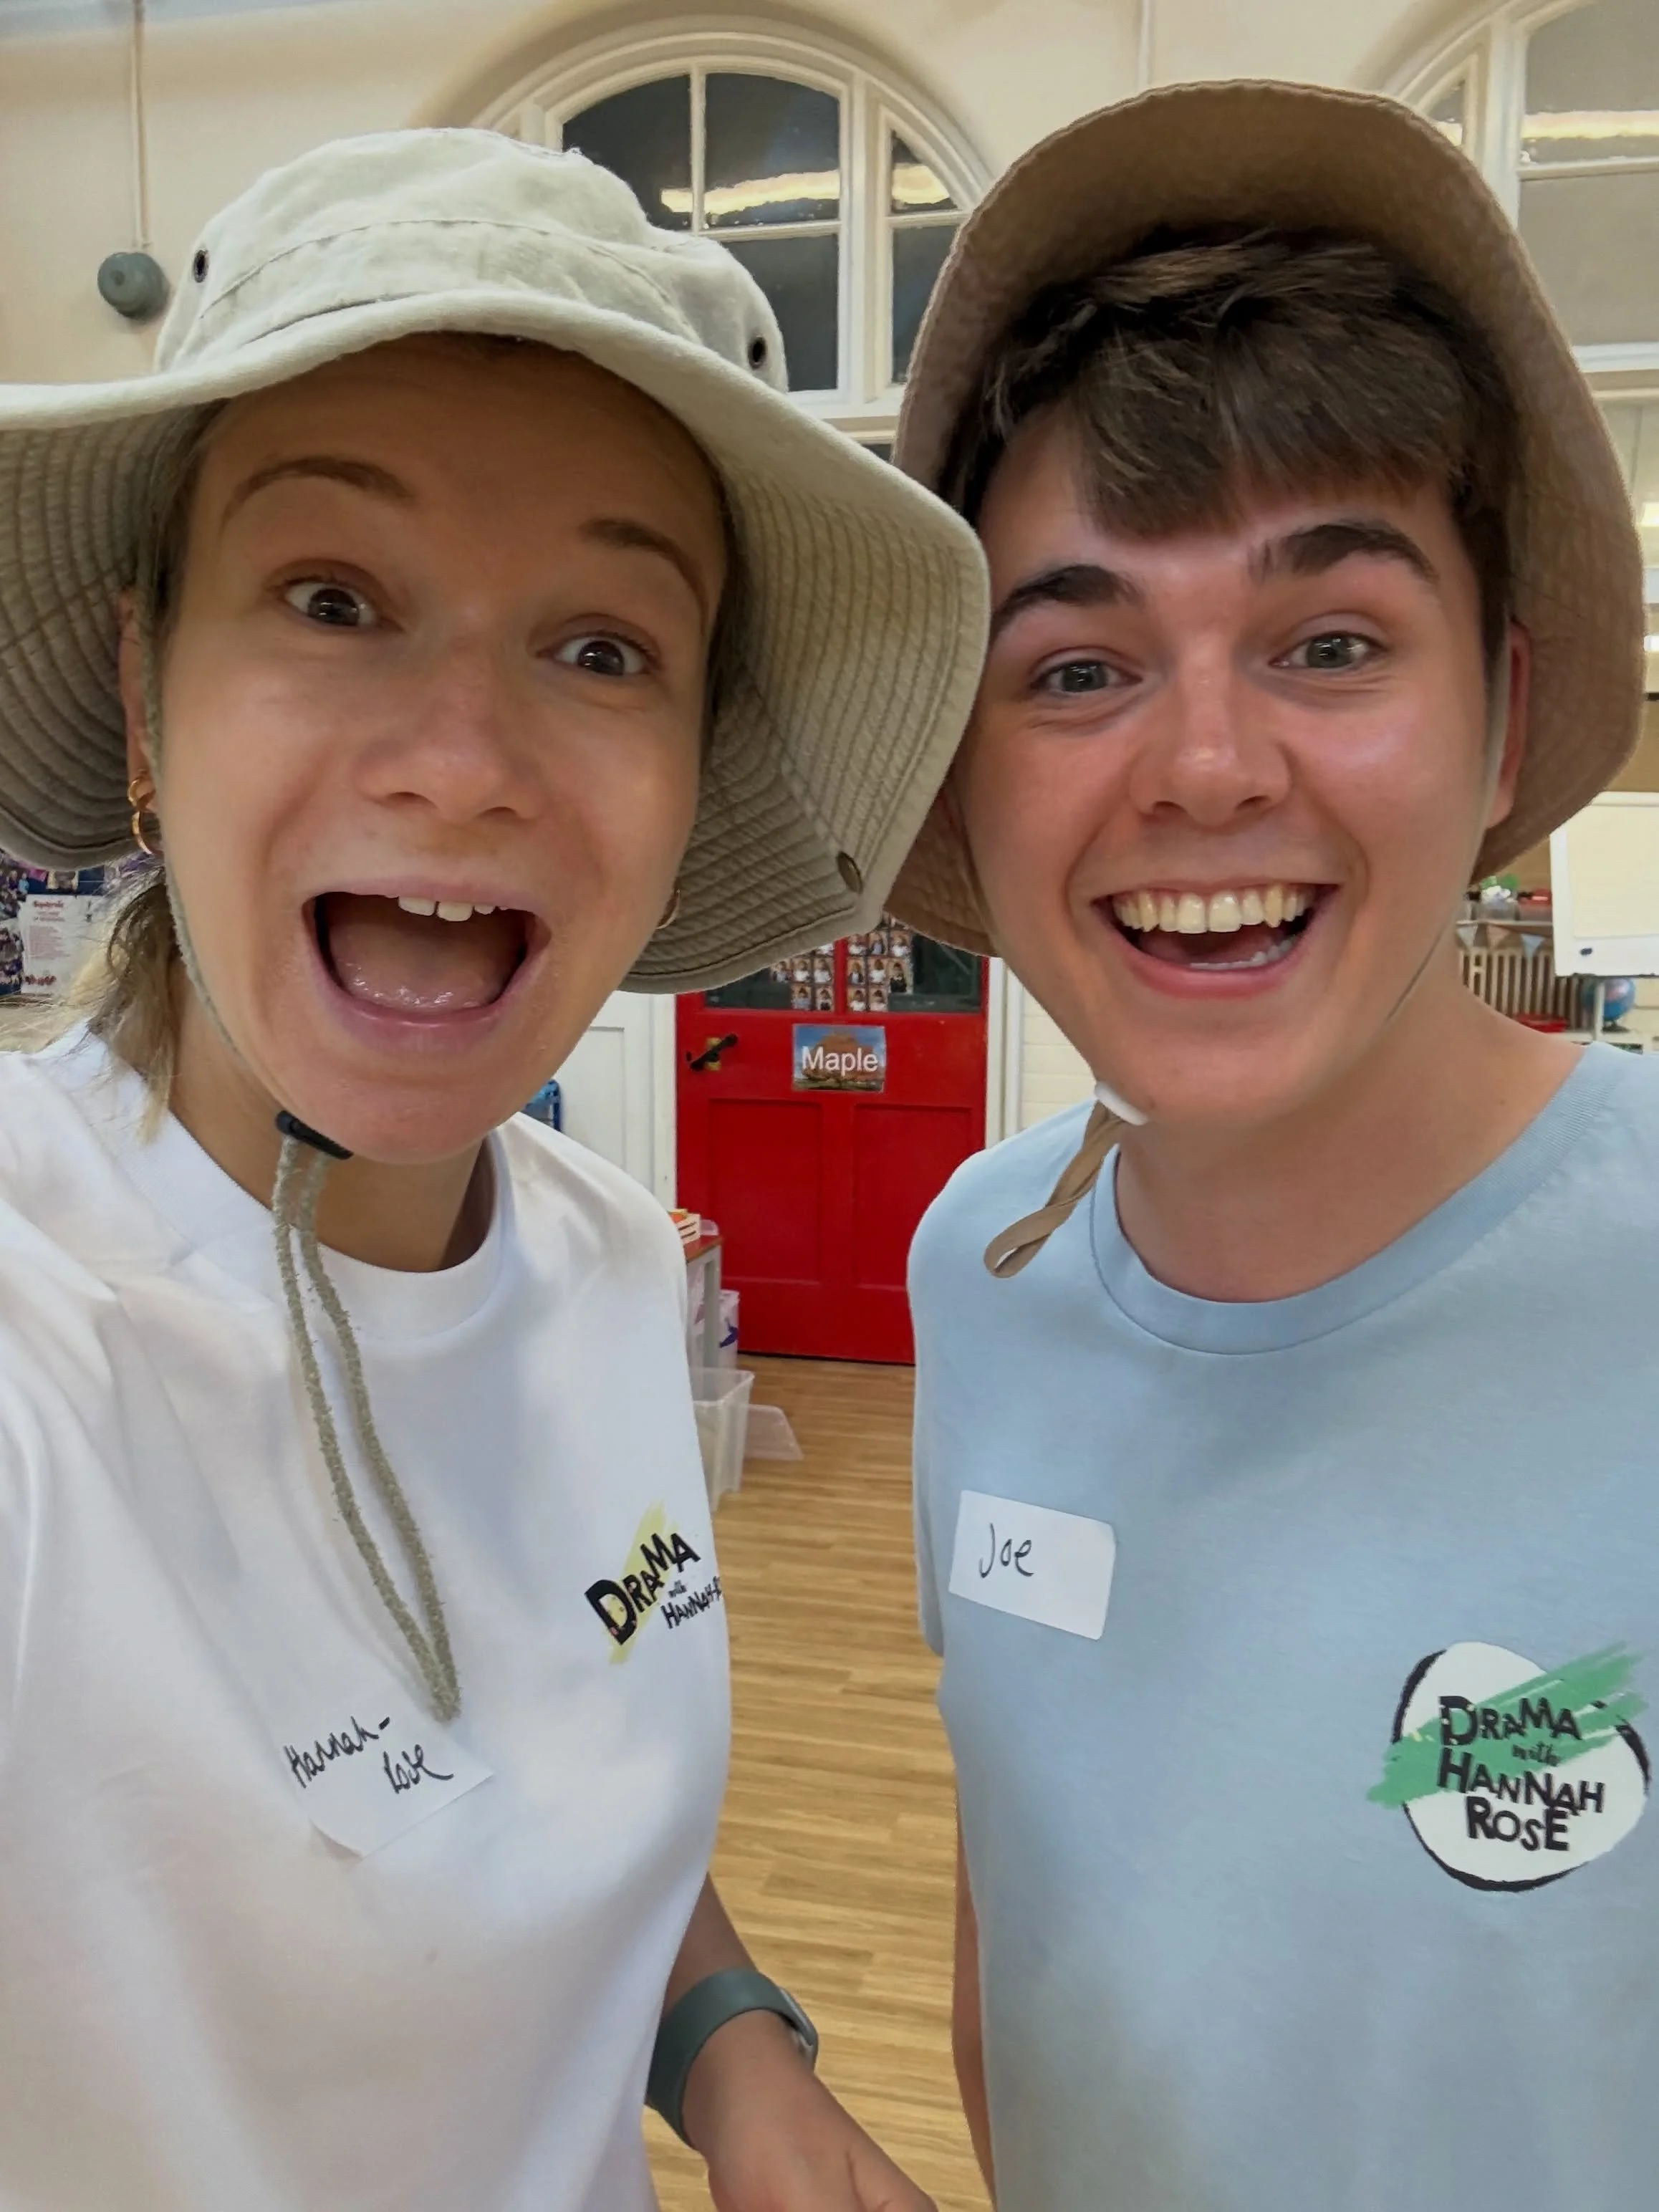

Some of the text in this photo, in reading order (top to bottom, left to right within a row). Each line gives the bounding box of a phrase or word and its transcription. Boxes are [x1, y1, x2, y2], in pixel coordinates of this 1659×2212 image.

[802, 1045, 878, 1077] Maple
[978, 1522, 1034, 1578] Joe
[584, 1532, 701, 1645] DRAMA
[1438, 1695, 1582, 1746] DRAMA
[1437, 1748, 1605, 1817] HANNAH
[1511, 1741, 1562, 1768] with
[1465, 1795, 1569, 1852] ROSE
